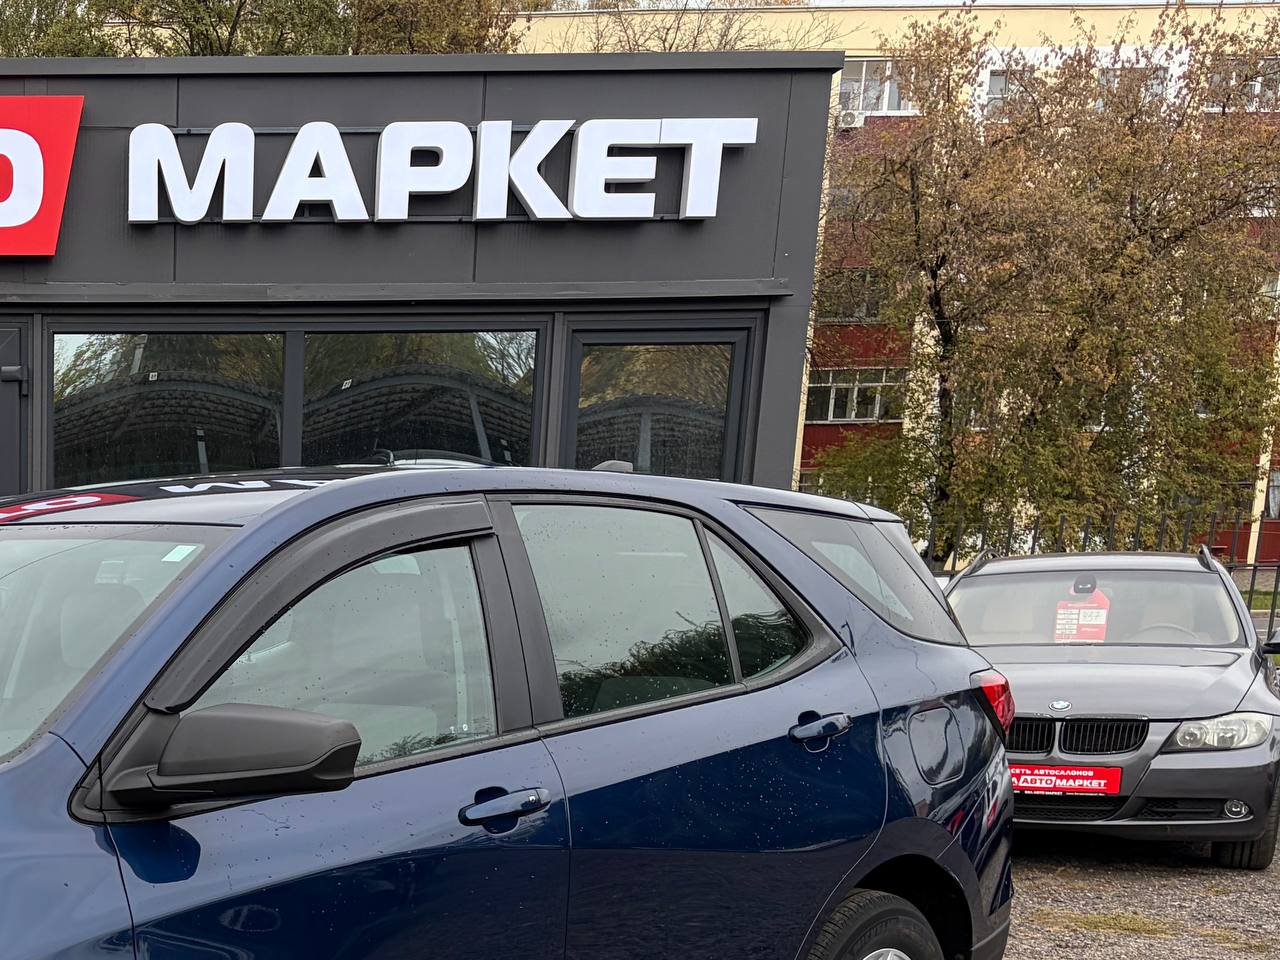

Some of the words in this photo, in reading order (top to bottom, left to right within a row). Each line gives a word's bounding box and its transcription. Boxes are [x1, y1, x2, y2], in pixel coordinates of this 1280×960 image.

[128, 117, 758, 225] МАРКЕТ
[1021, 777, 1053, 785] АВТО
[1056, 778, 1108, 787] МАРКЕТ
